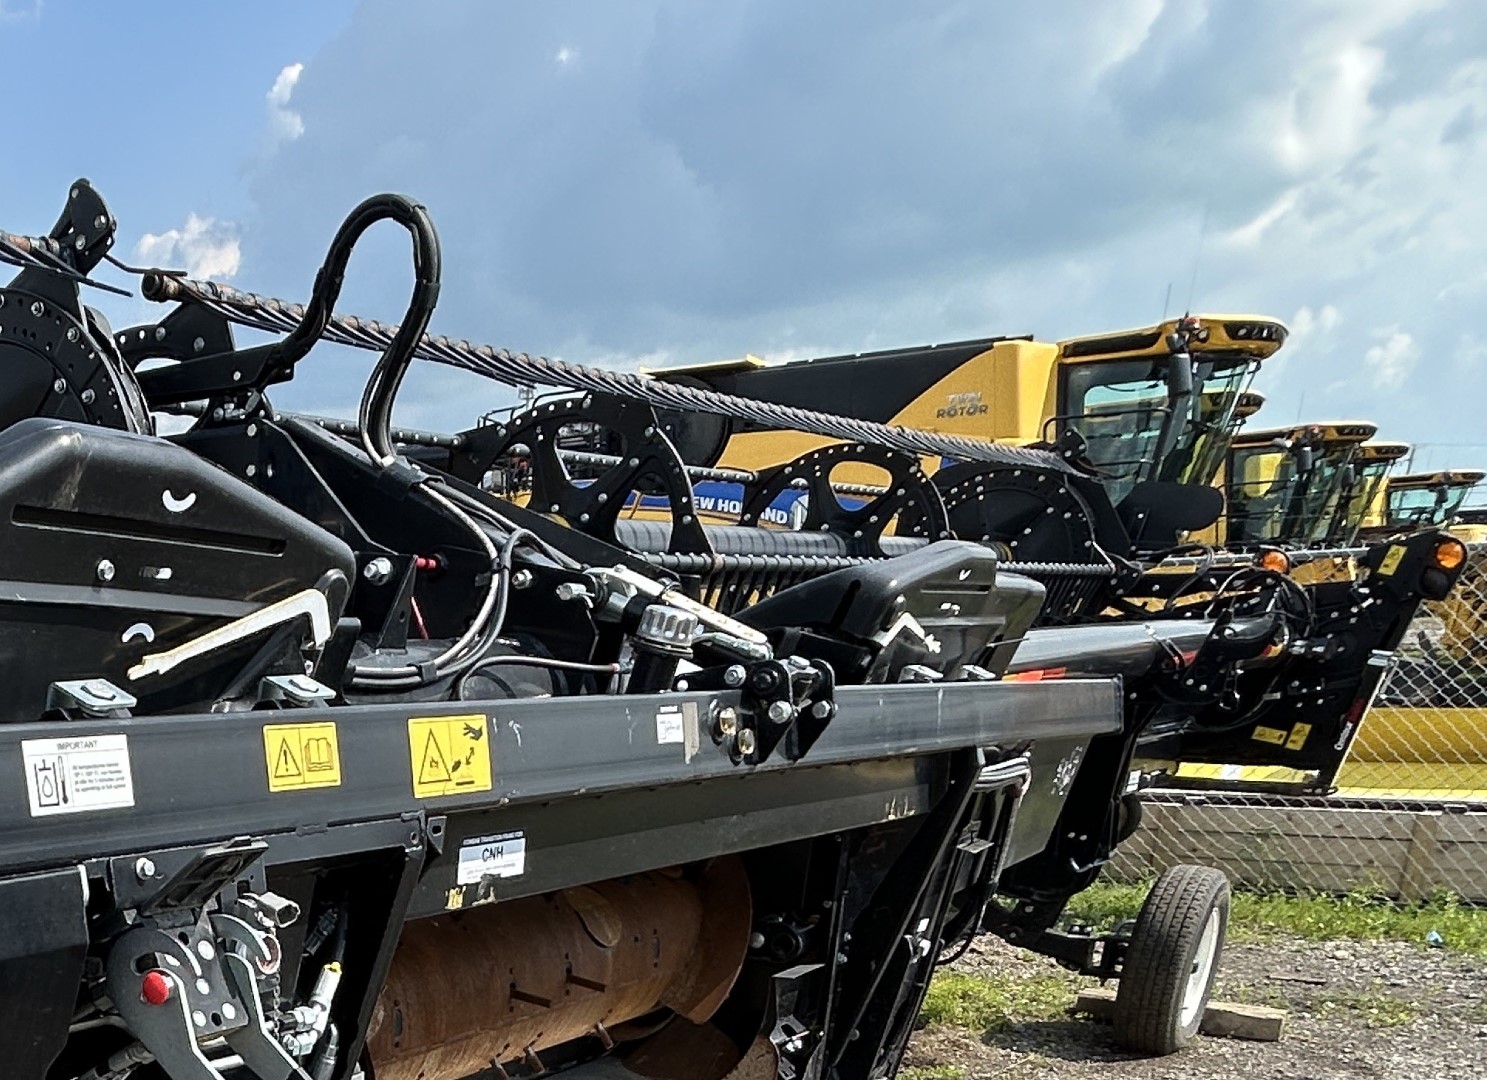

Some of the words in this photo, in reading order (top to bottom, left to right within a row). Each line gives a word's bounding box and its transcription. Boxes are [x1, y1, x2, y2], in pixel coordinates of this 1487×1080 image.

[936, 404, 988, 418] ROTOR
[693, 496, 715, 510] EW
[718, 498, 788, 524] HOND
[57, 740, 98, 750] IMPORTANT
[482, 845, 504, 862] CNH
